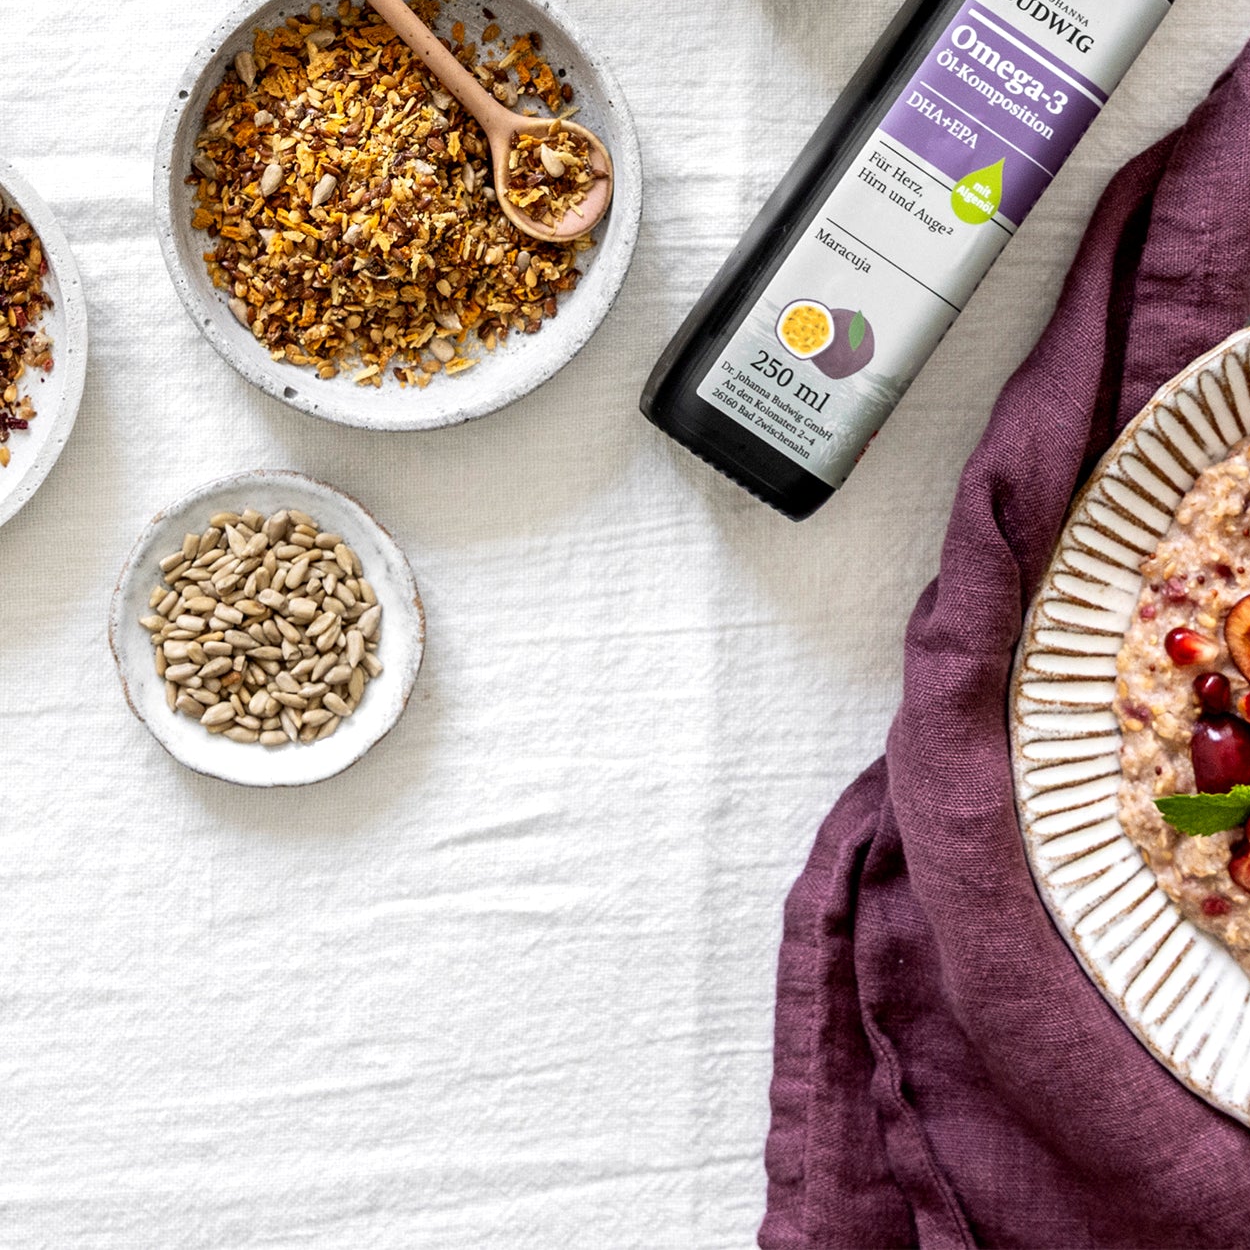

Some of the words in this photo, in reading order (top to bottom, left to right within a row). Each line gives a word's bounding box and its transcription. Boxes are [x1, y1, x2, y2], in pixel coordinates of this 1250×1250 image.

[937, 49, 1054, 140] Öl-Komposition
[951, 24, 1068, 115] Omega-3
[906, 91, 979, 149] DHA+EPA
[857, 167, 887, 192] Hirn
[889, 188, 916, 213] und
[869, 151, 892, 172] Für
[892, 167, 924, 197] Herz,
[956, 185, 994, 215] Algenöl
[973, 182, 991, 197] mit
[815, 228, 871, 273] Maracuja
[722, 361, 734, 374] Dr.
[733, 370, 770, 399] Johanna
[772, 394, 803, 423] Budwig
[804, 418, 833, 441] GmbH
[722, 379, 735, 392] An
[736, 388, 754, 403] den
[754, 399, 797, 433] Kolonaten
[750, 350, 794, 387] 250
[794, 383, 830, 413] ml
[712, 388, 738, 408] 26160
[738, 405, 754, 421] Bad
[754, 417, 810, 459] Zwischenahn
